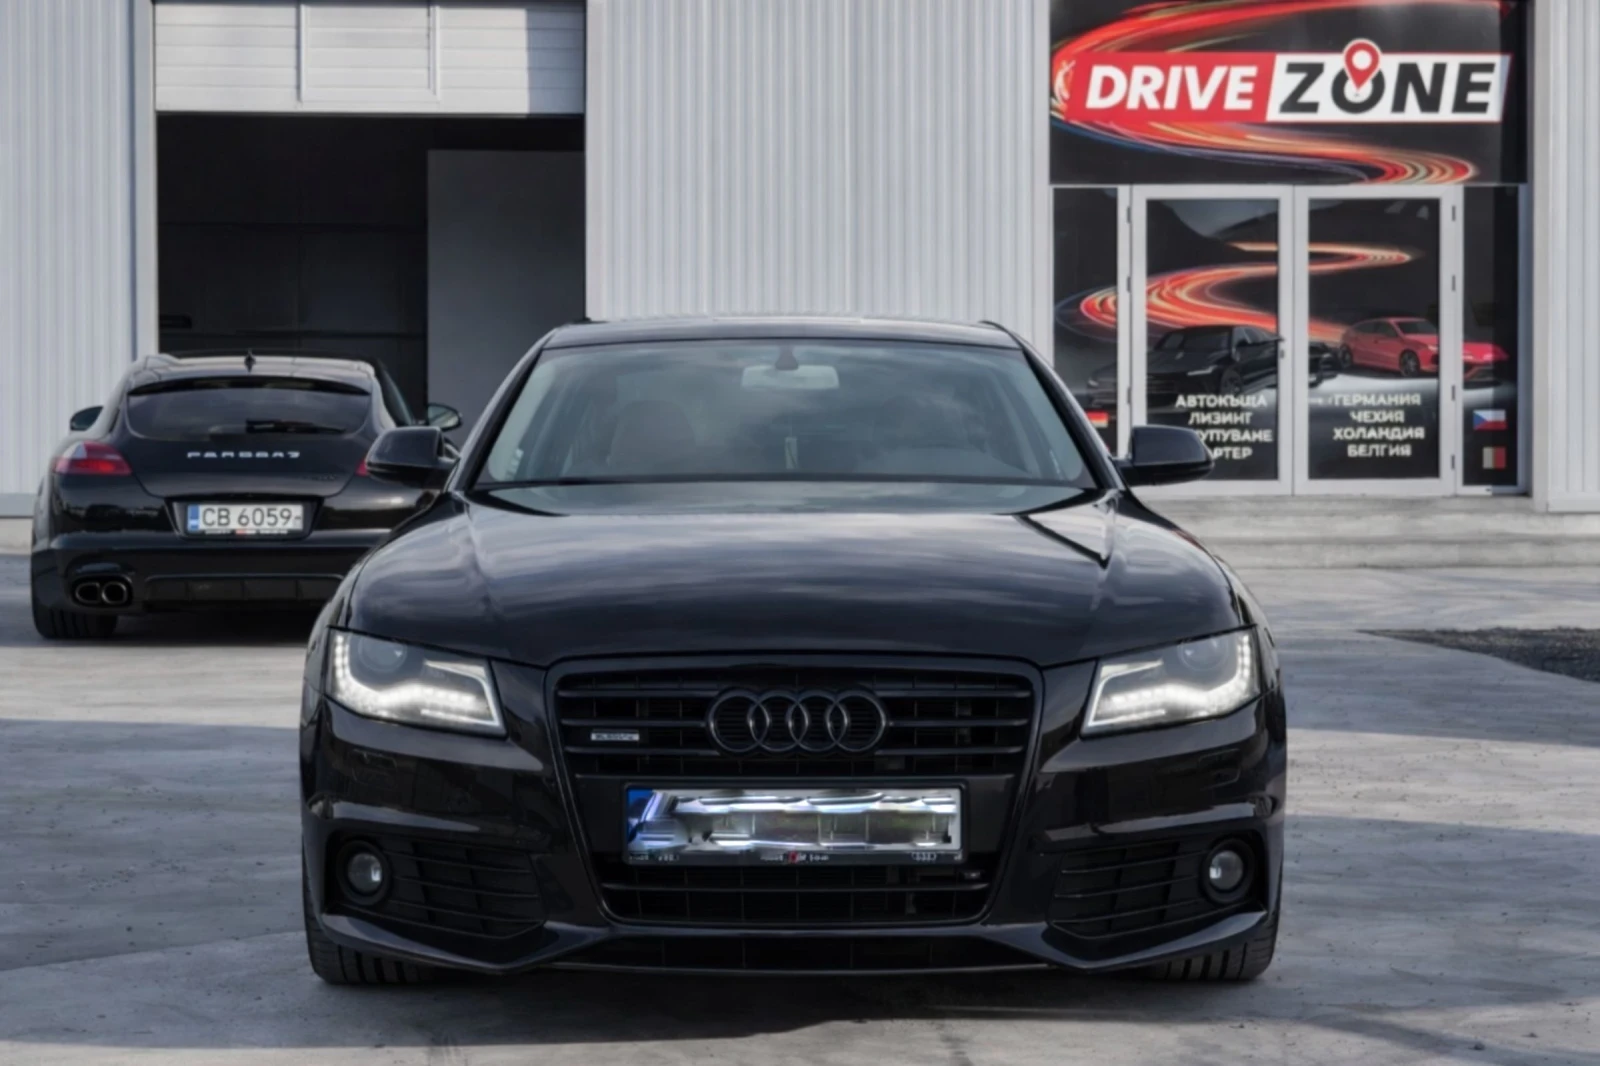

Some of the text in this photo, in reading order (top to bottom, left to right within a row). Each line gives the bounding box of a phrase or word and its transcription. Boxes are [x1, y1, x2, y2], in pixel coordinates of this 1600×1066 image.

[1085, 62, 1496, 115] DRIVE ZONE
[1175, 394, 1268, 408] АВТОКЪЩА
[1333, 393, 1422, 407] ГЕРМАНИЯ
[1188, 411, 1253, 425] ЛИЗИНГ
[1349, 410, 1405, 423] ЧЕХИЯ
[1197, 429, 1273, 442] УПУВАНЕ
[1333, 426, 1425, 440] ХОЛАНДИЯ
[1213, 446, 1253, 459] РТЕР
[1347, 443, 1412, 457] БЕЛГИЯ
[202, 507, 231, 527] CB
